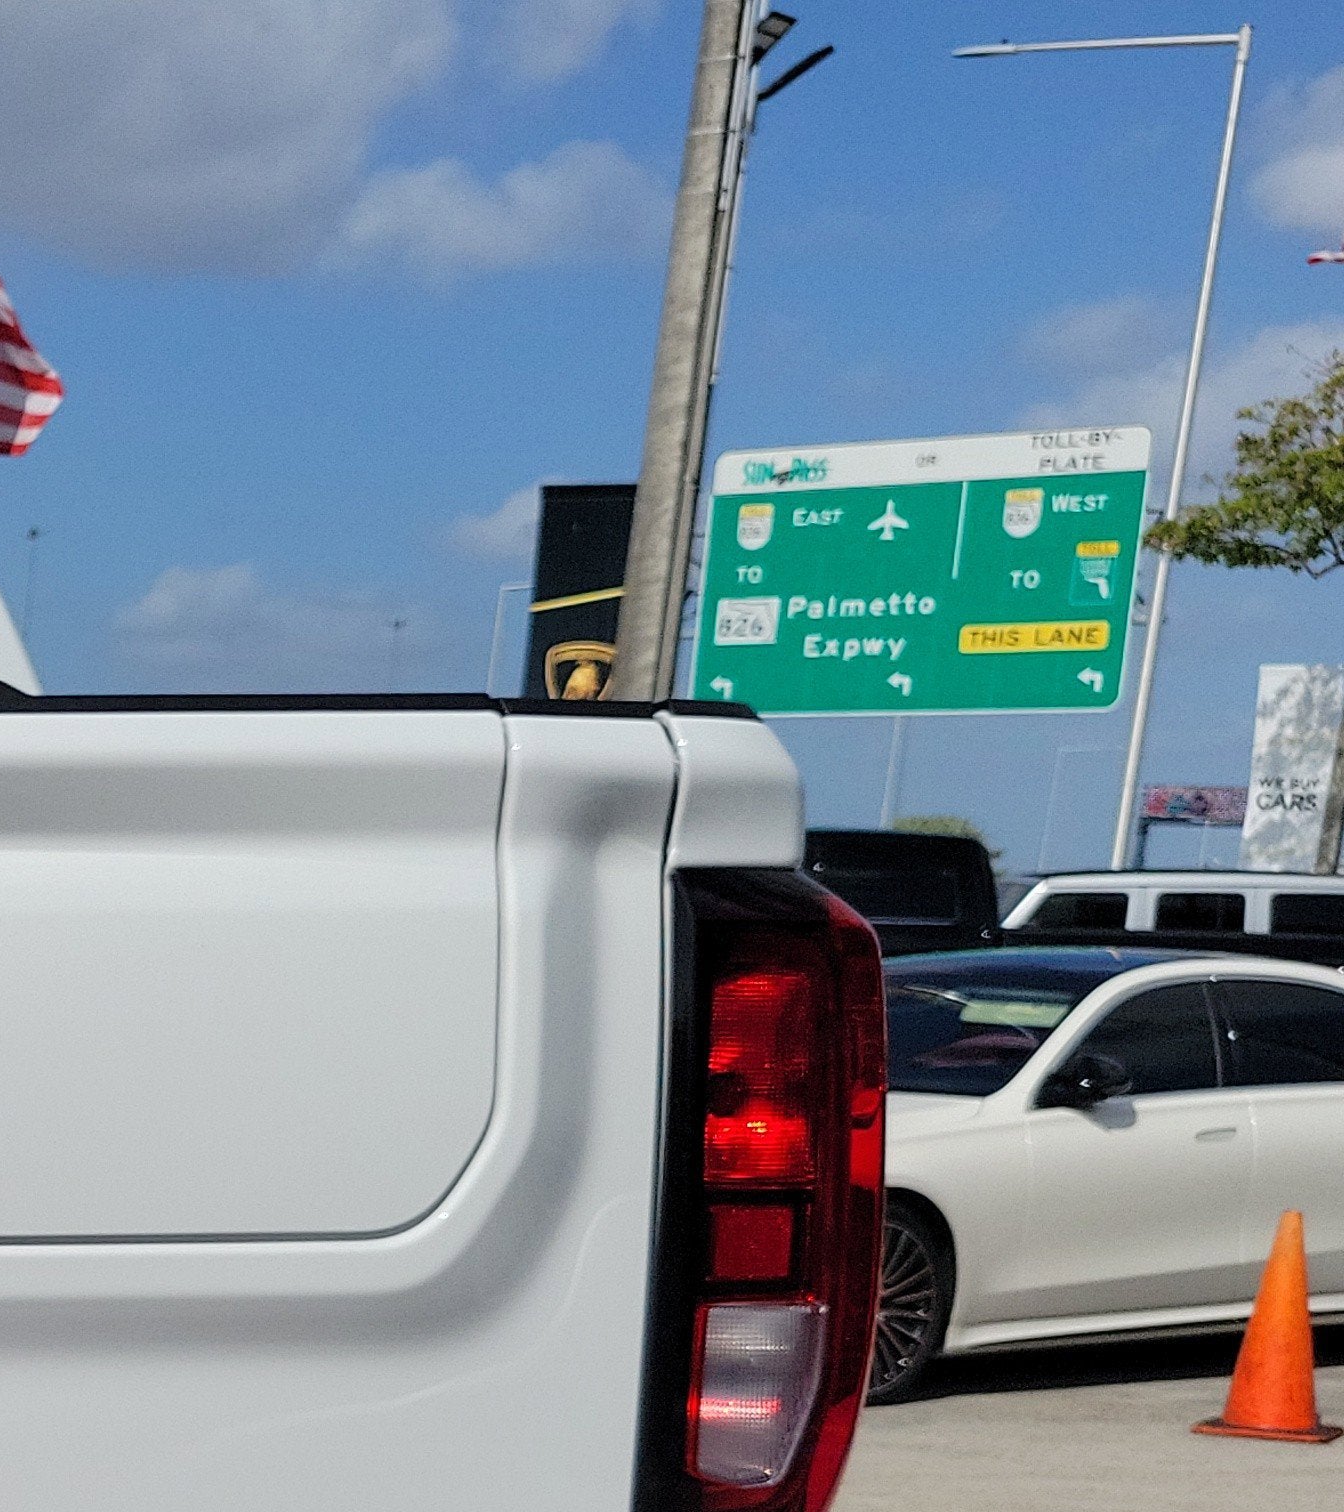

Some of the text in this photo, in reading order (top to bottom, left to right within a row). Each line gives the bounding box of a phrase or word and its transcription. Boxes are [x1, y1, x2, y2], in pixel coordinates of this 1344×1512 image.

[1039, 455, 1105, 472] PLATE
[1051, 492, 1109, 513] WEST
[792, 507, 844, 528] EAST
[736, 565, 763, 585] TO
[1009, 569, 1041, 590] TO
[787, 591, 936, 620] Palmetto
[969, 625, 1100, 648] THIS LANE
[803, 633, 907, 662] Expwy
[1289, 777, 1320, 790] BUY
[1255, 793, 1318, 812] CARS
